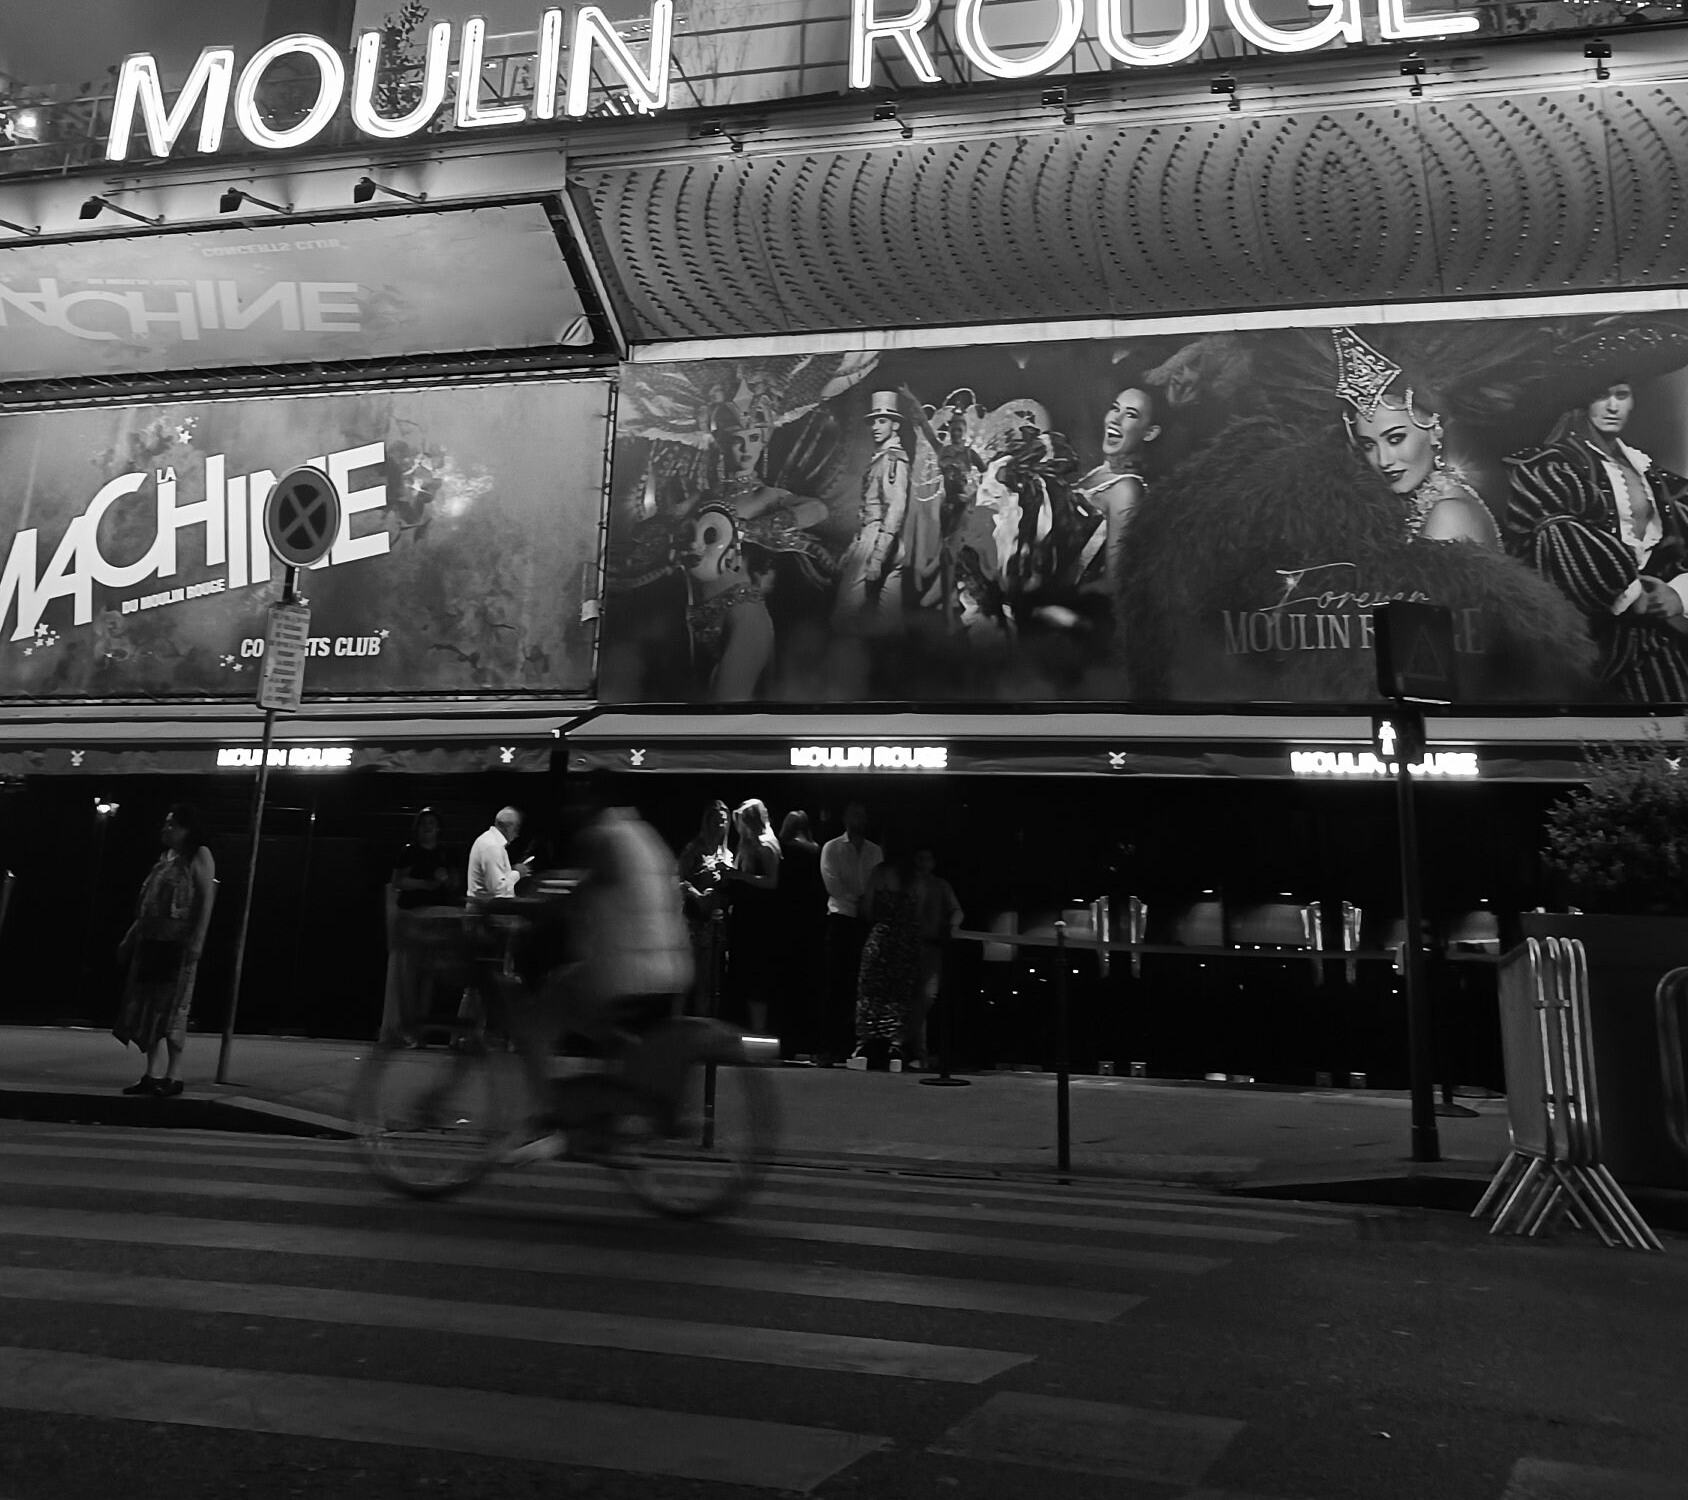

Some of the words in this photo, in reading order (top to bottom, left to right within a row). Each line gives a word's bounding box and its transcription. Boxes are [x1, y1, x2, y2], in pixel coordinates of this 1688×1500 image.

[157, 466, 176, 484] LA
[1222, 610, 1351, 655] MOULIN
[240, 637, 331, 658] COTS
[334, 636, 381, 656] CLUB
[1389, 752, 1480, 775] UGE
